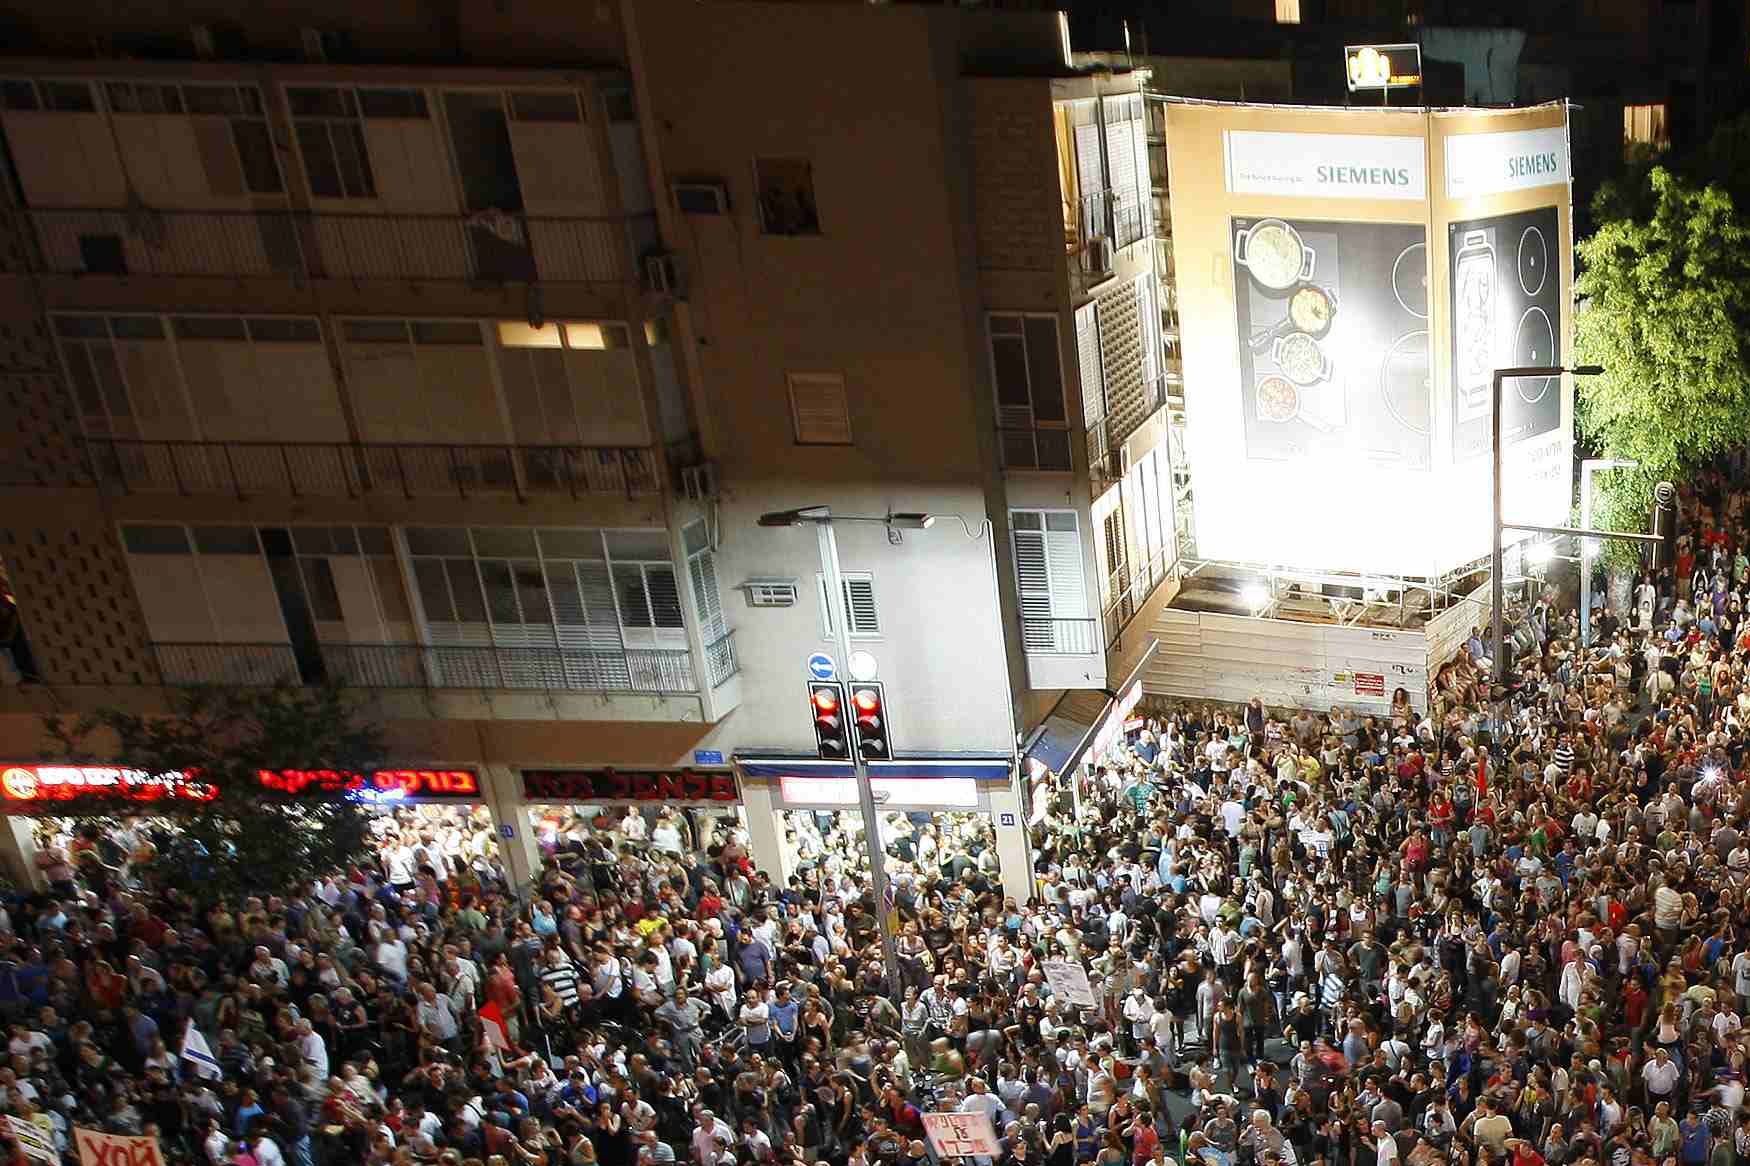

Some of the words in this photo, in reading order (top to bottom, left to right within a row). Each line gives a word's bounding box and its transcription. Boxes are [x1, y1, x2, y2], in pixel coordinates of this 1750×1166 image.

[1317, 165, 1409, 186] SIEMENS
[1509, 153, 1557, 177] SIEMENS
[374, 769, 475, 794] בורקס
